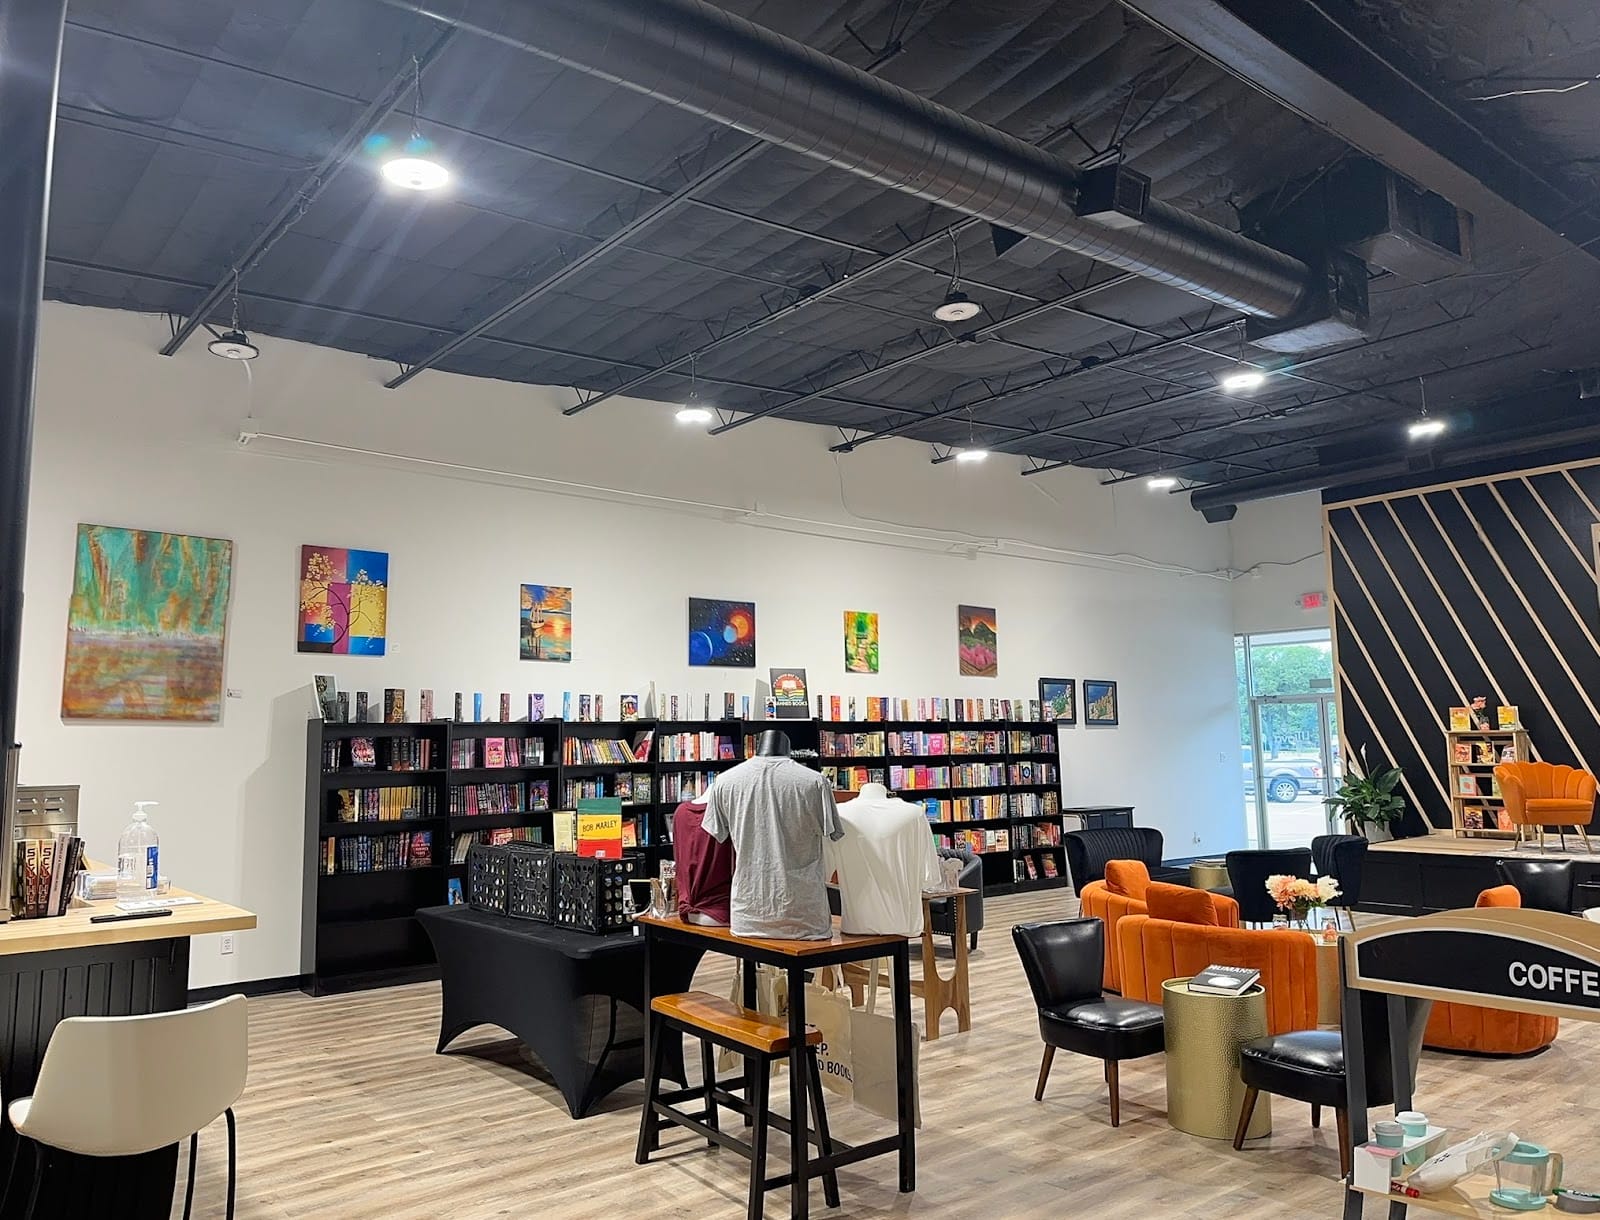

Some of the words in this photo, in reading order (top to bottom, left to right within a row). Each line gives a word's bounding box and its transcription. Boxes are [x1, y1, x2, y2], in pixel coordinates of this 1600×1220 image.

[582, 823, 594, 833] BOB
[595, 820, 617, 830] MARLEY
[26, 848, 37, 905] SCYTHE
[38, 847, 52, 904] SCYTHE
[1508, 961, 1600, 997] COFFE
